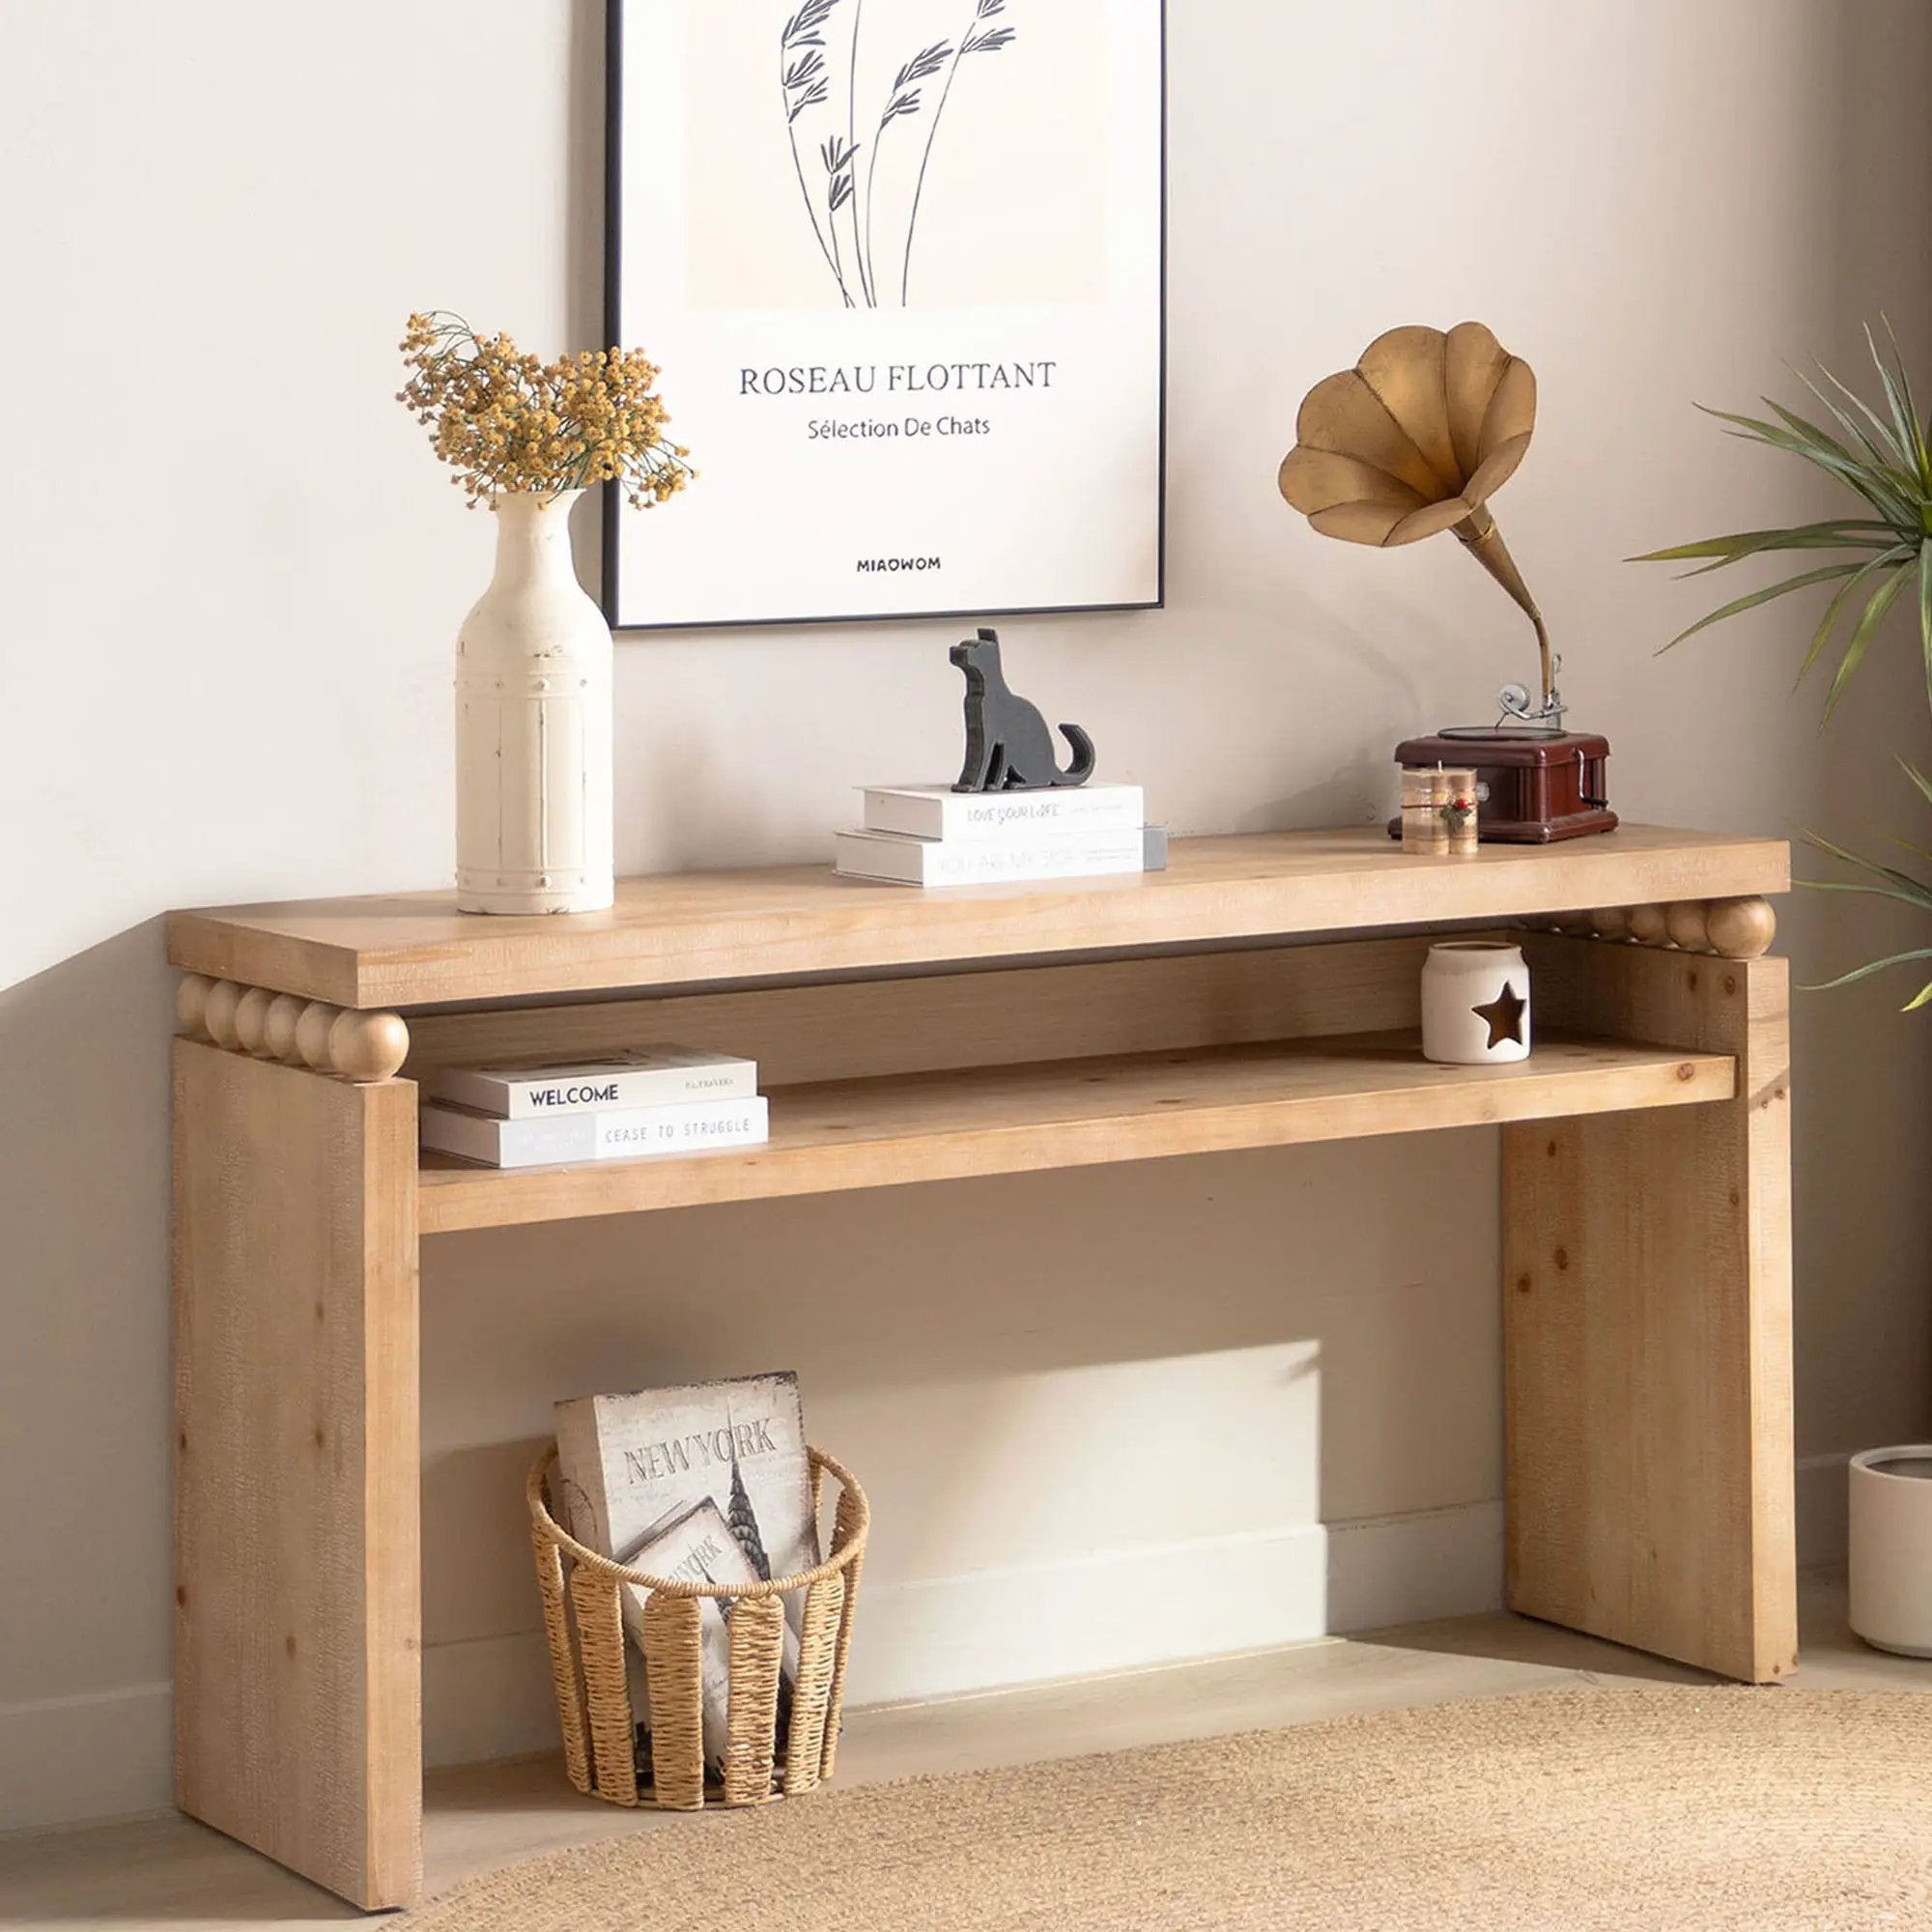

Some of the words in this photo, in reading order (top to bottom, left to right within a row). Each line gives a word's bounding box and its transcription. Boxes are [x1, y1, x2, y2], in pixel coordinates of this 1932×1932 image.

[740, 366, 876, 395] ROSEAU
[888, 361, 1057, 390] FLOTTANT
[808, 419, 898, 439] Sélection
[904, 417, 932, 437] De
[936, 416, 990, 436] Chats
[857, 556, 941, 572] MIAOWOM
[529, 1084, 619, 1107] WELCOME
[606, 1127, 648, 1144] CEASE
[659, 1123, 674, 1139] TO
[684, 1118, 752, 1138] STRUGGLE
[623, 1435, 691, 1485] NEW
[690, 1417, 777, 1466] YORK
